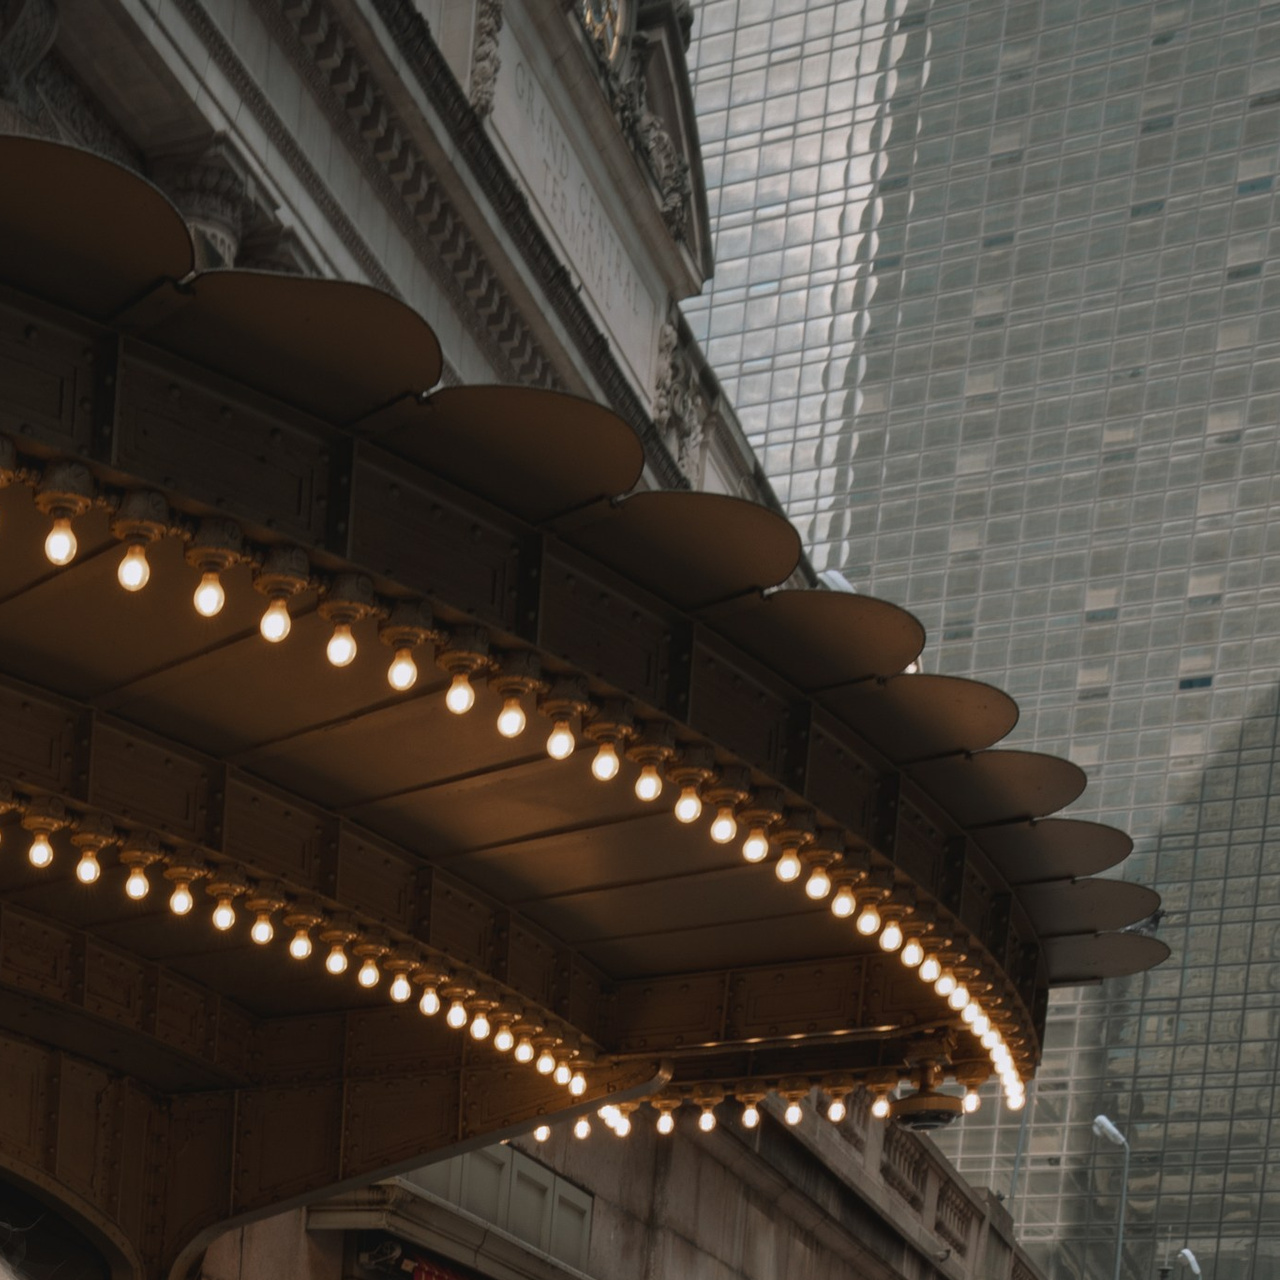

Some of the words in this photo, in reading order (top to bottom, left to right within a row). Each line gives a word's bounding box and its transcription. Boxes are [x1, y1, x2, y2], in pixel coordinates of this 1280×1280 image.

[515, 61, 570, 181] GRAND
[579, 181, 640, 315] CENTRAL
[543, 156, 613, 312] TERMINAL
